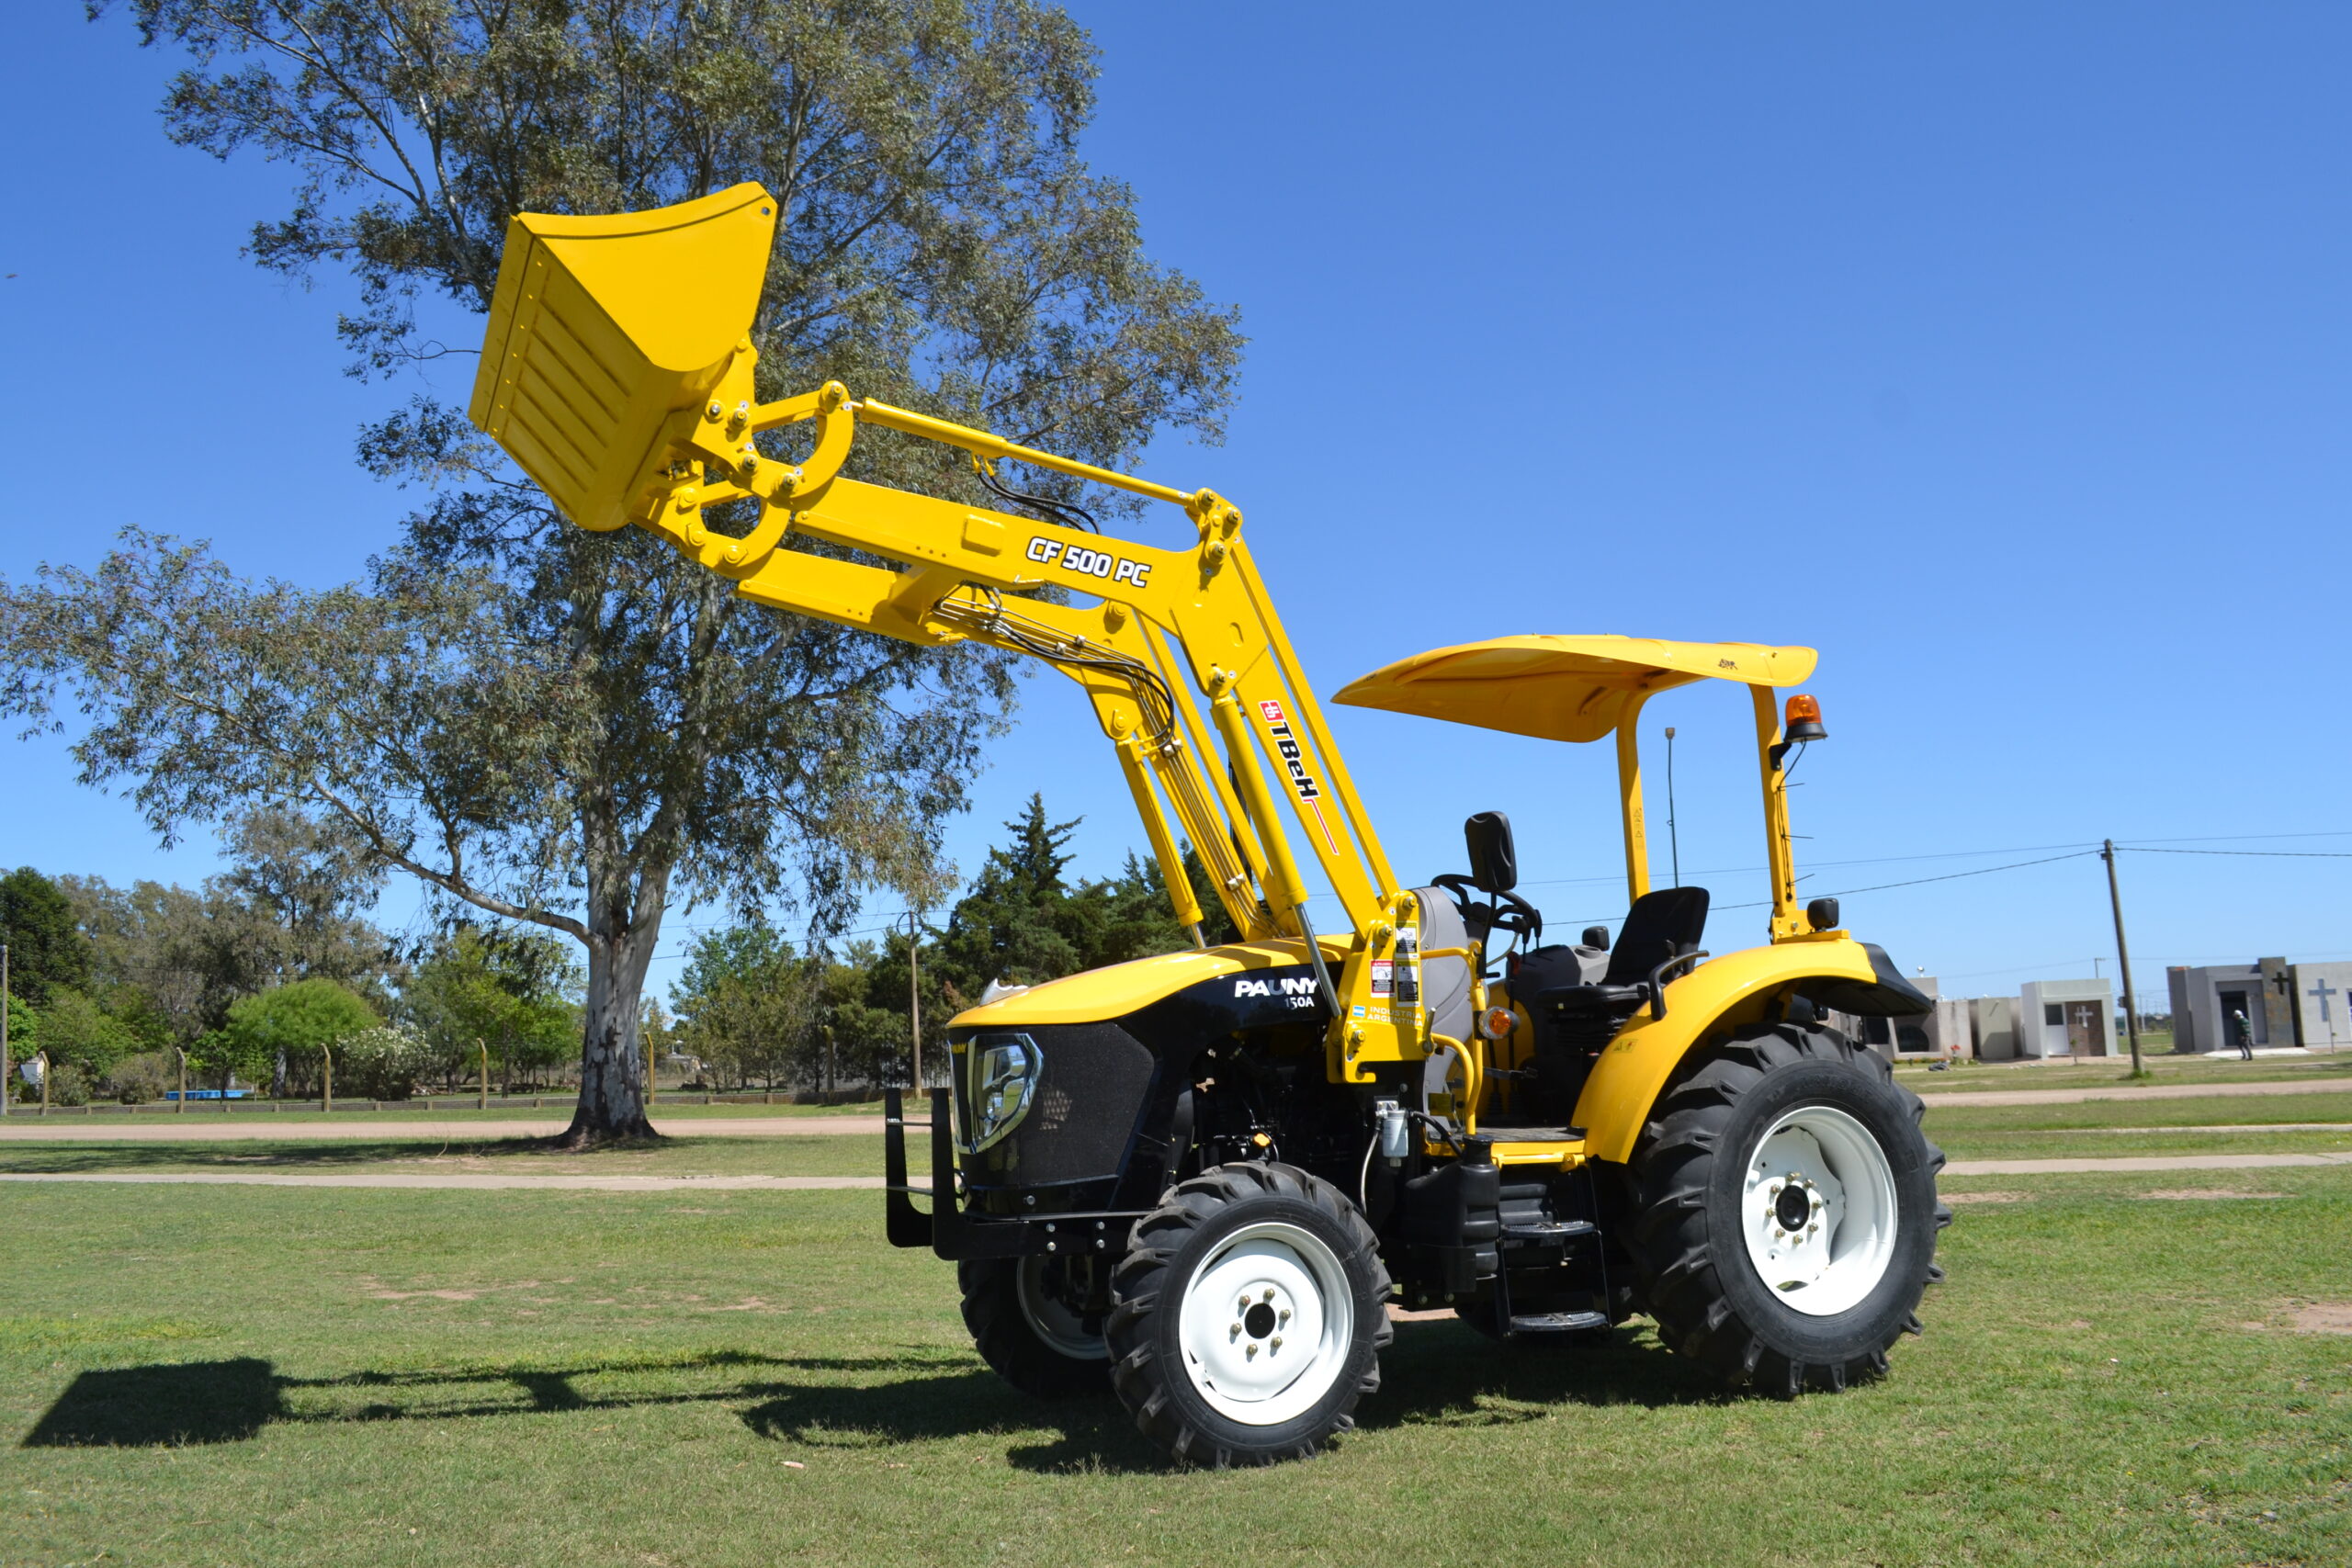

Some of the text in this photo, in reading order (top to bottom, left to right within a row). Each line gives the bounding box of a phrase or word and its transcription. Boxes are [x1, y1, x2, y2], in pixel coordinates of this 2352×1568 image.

[1026, 536, 1152, 588] CF 500 PC
[1271, 721, 1319, 797] TBeH
[1235, 977, 1317, 998] PAUNY
[1285, 996, 1315, 1010] 150A
[1367, 1014, 1423, 1027] ARGENTINA
[1370, 1007, 1422, 1020] INDUSTRIA
